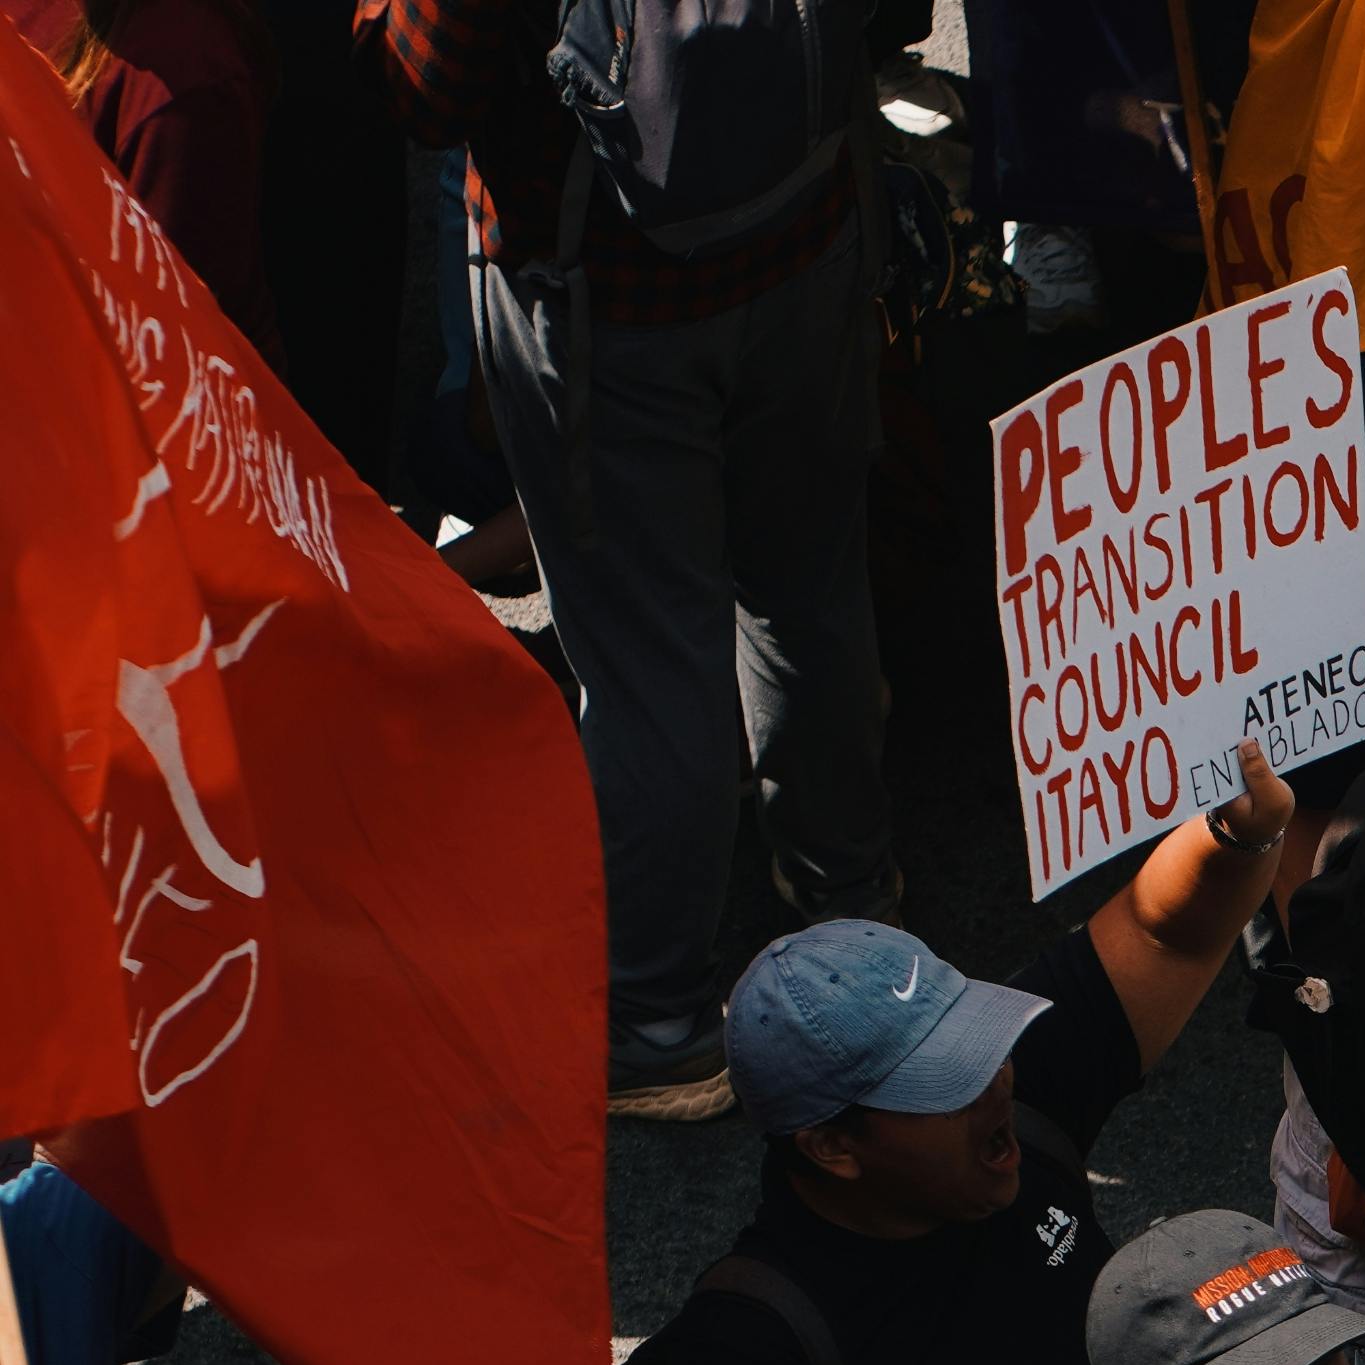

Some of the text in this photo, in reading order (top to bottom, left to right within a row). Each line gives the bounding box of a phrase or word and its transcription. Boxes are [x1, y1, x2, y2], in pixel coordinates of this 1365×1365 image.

[1000, 290, 1355, 577] PEOPLE'S
[1002, 446, 1360, 676] TRANSITION
[1017, 590, 1259, 776] COUNCIL
[1032, 728, 1180, 880] ITAYO
[1205, 1281, 1267, 1323] ROGUE
